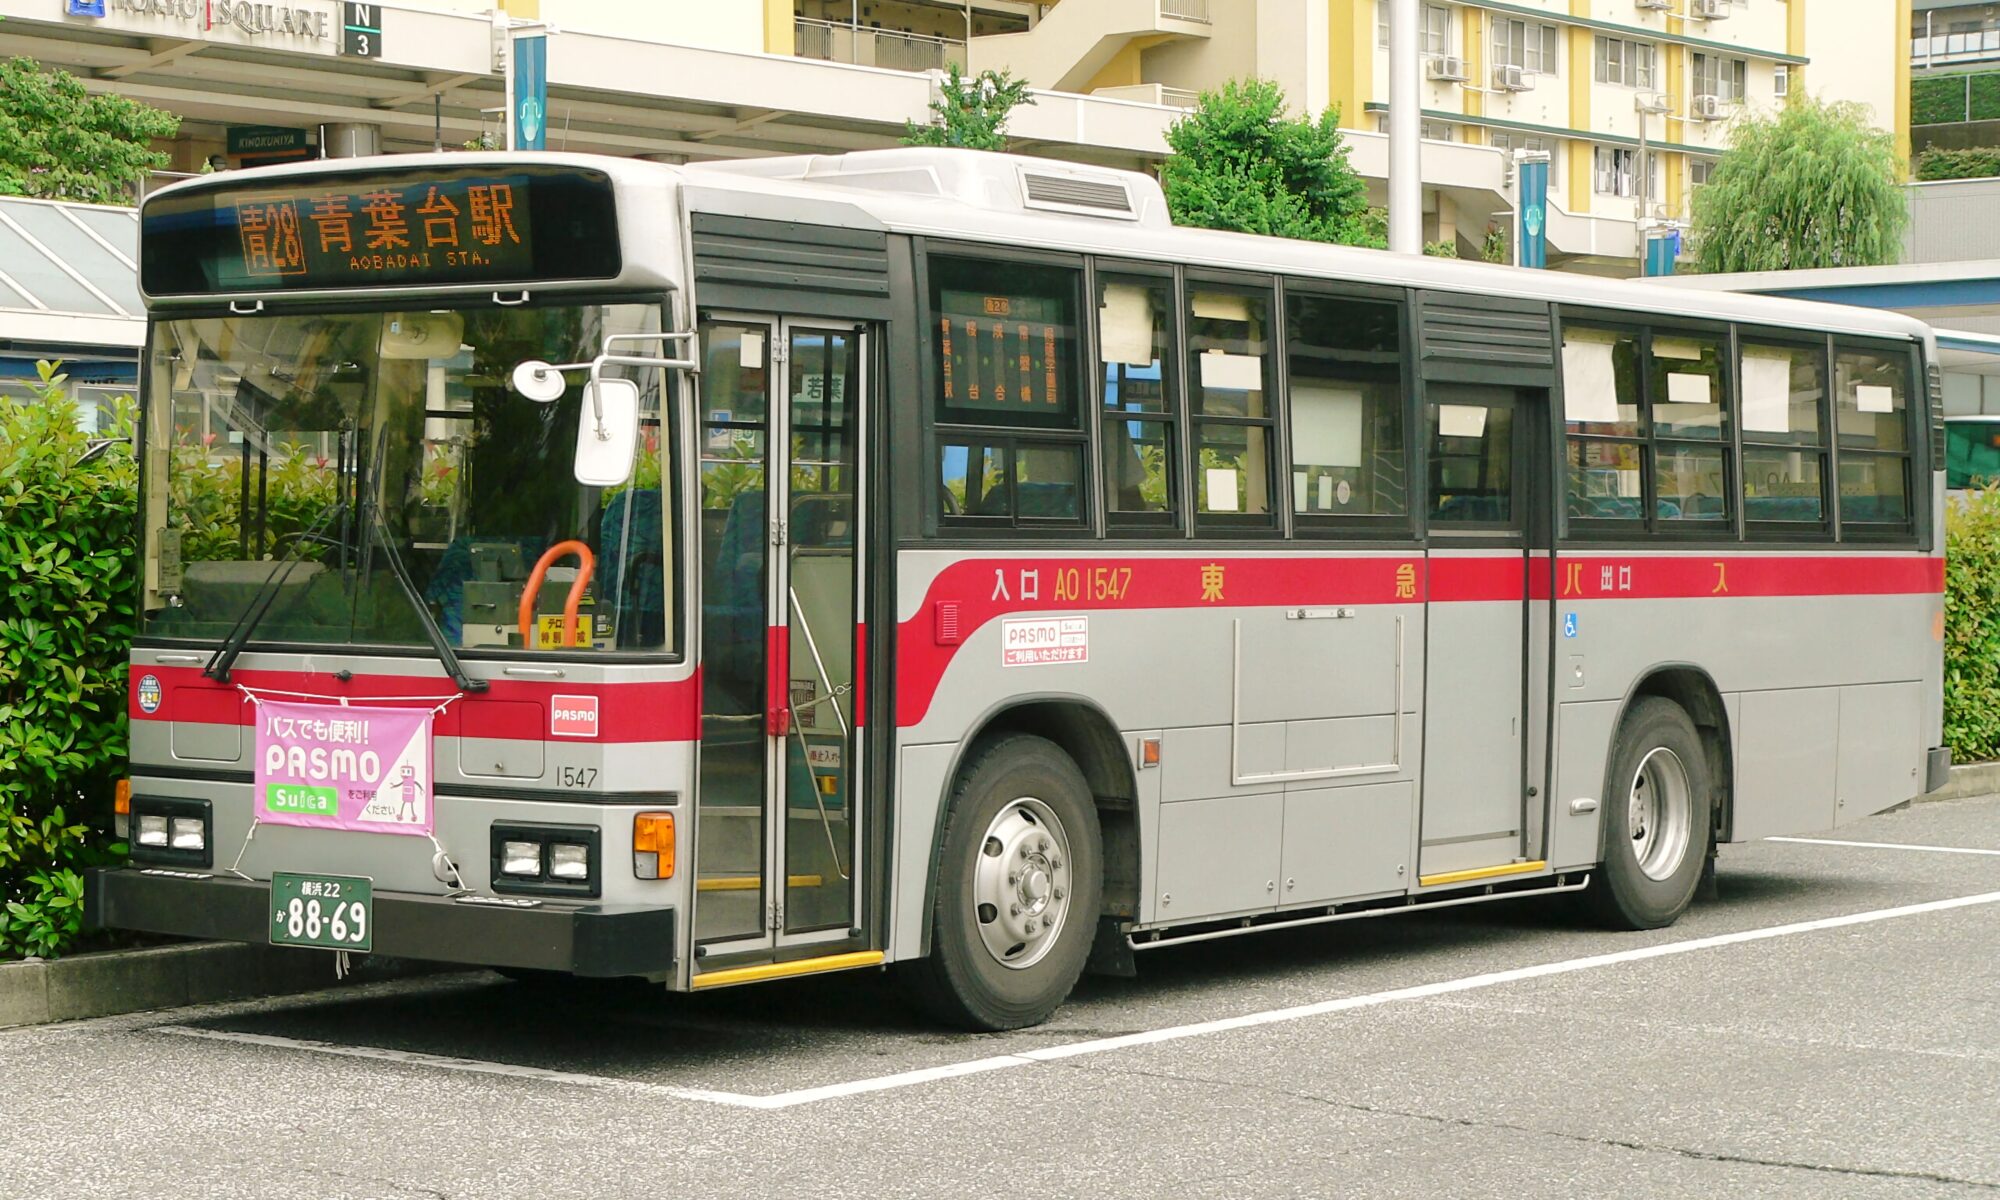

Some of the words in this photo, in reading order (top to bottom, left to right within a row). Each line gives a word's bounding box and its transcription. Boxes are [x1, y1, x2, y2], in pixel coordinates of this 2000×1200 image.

[211, 0, 329, 37] SQUARE
[355, 4, 371, 26] N
[357, 35, 369, 55] 3
[239, 134, 294, 149] KINOKUNIYA
[309, 184, 521, 253] 青葉台駅
[350, 254, 431, 270] AOBADAI
[447, 252, 492, 266] STA.
[991, 568, 1039, 601] 入口
[1200, 562, 1226, 602] 東
[1396, 563, 1416, 599] 急
[1600, 565, 1631, 591] 出口
[1009, 627, 1057, 644] PASMO
[1007, 647, 1085, 664] ご利用いただけます
[554, 709, 595, 722] PASMO
[265, 717, 370, 746] バスでも便利!
[265, 744, 381, 784] PASMO
[556, 765, 598, 788] 1547
[275, 789, 328, 810] Suica
[366, 804, 396, 816] ください
[276, 909, 287, 923] か
[288, 897, 366, 943] 88-69
